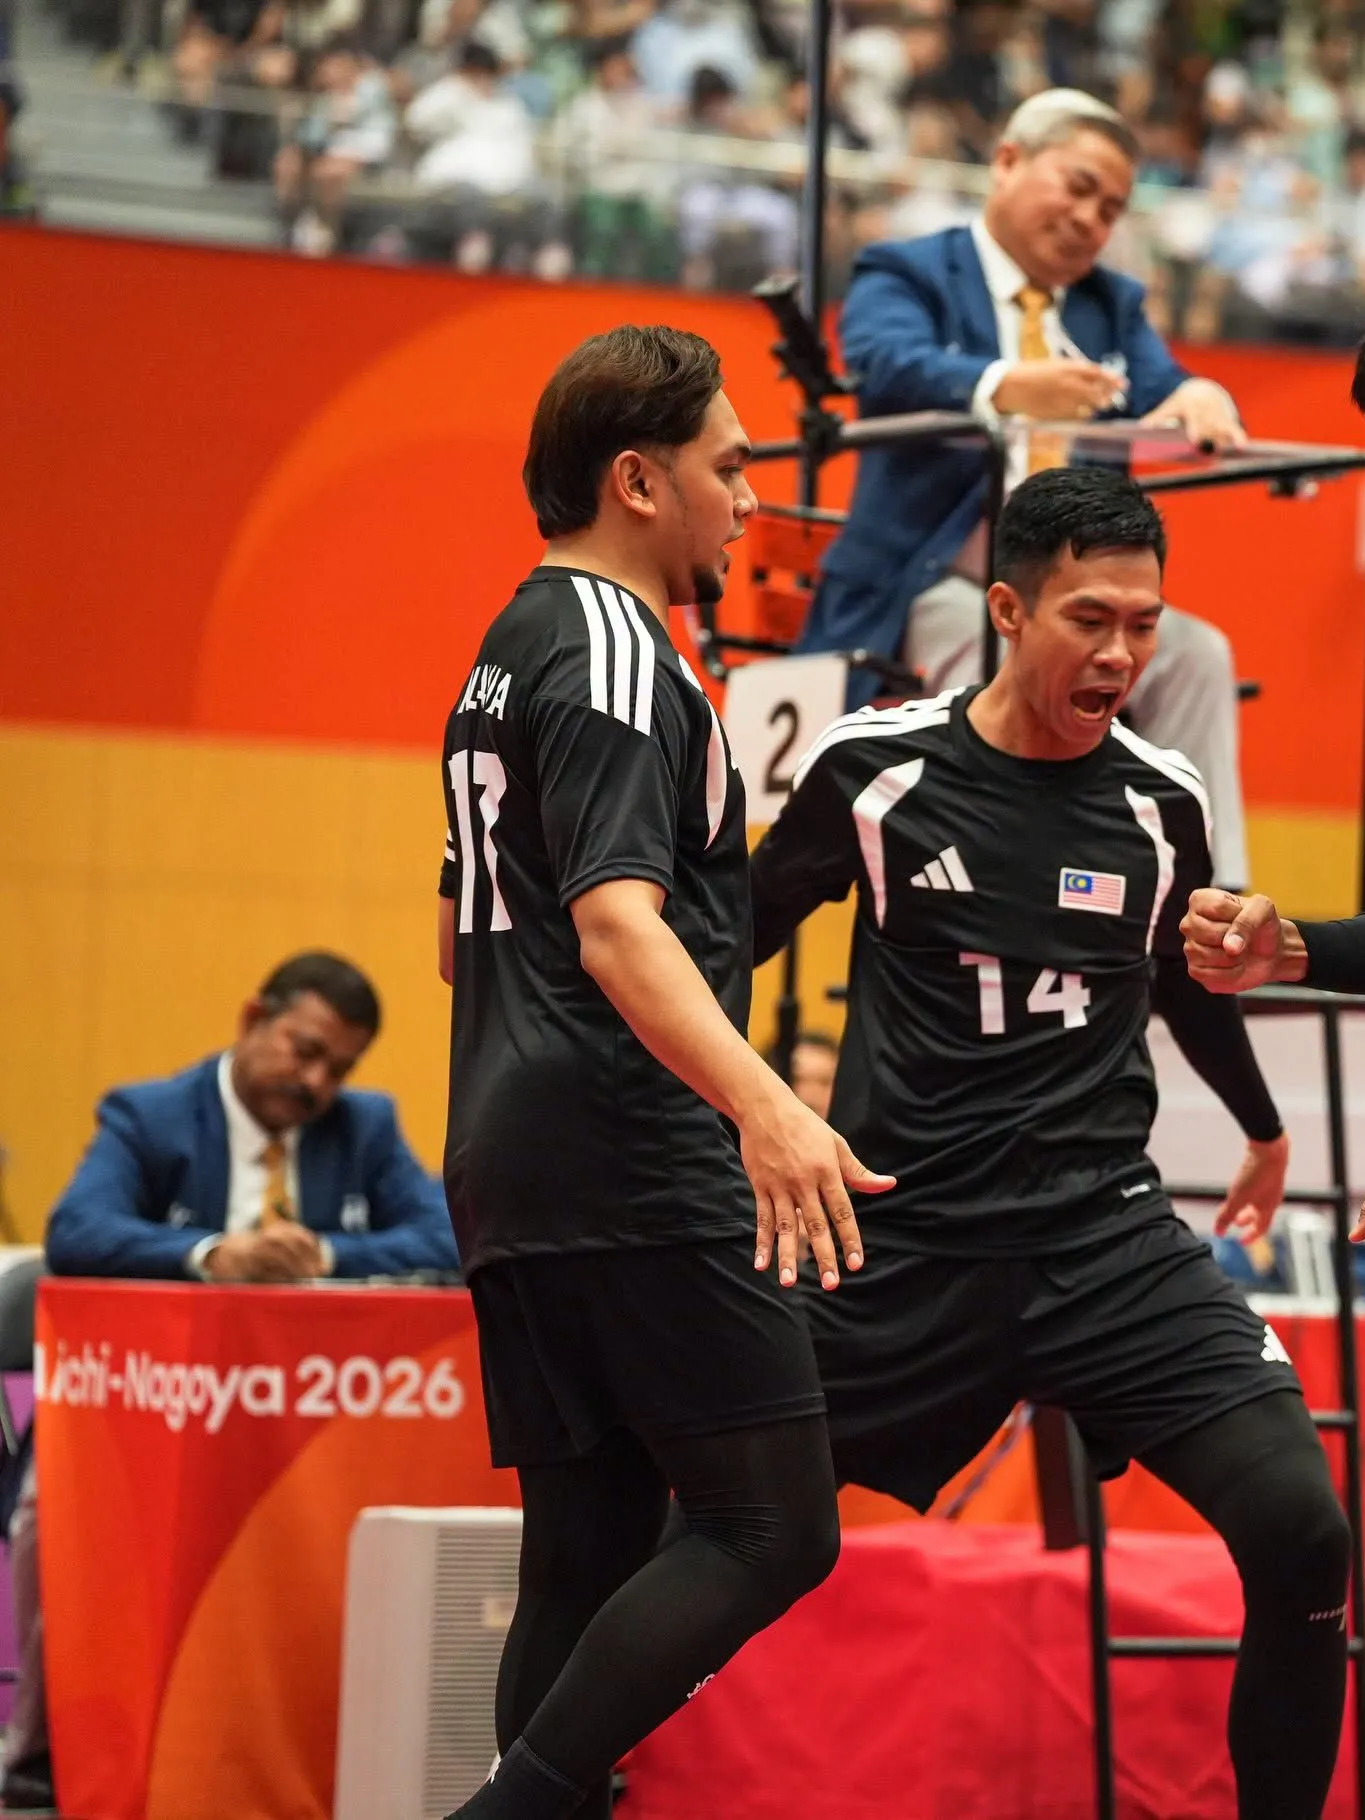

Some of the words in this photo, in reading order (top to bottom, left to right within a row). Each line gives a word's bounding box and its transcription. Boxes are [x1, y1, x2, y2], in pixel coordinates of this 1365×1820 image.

[766, 700, 799, 793] 2
[959, 952, 1091, 1034] 14
[296, 1355, 464, 1418] 2026
